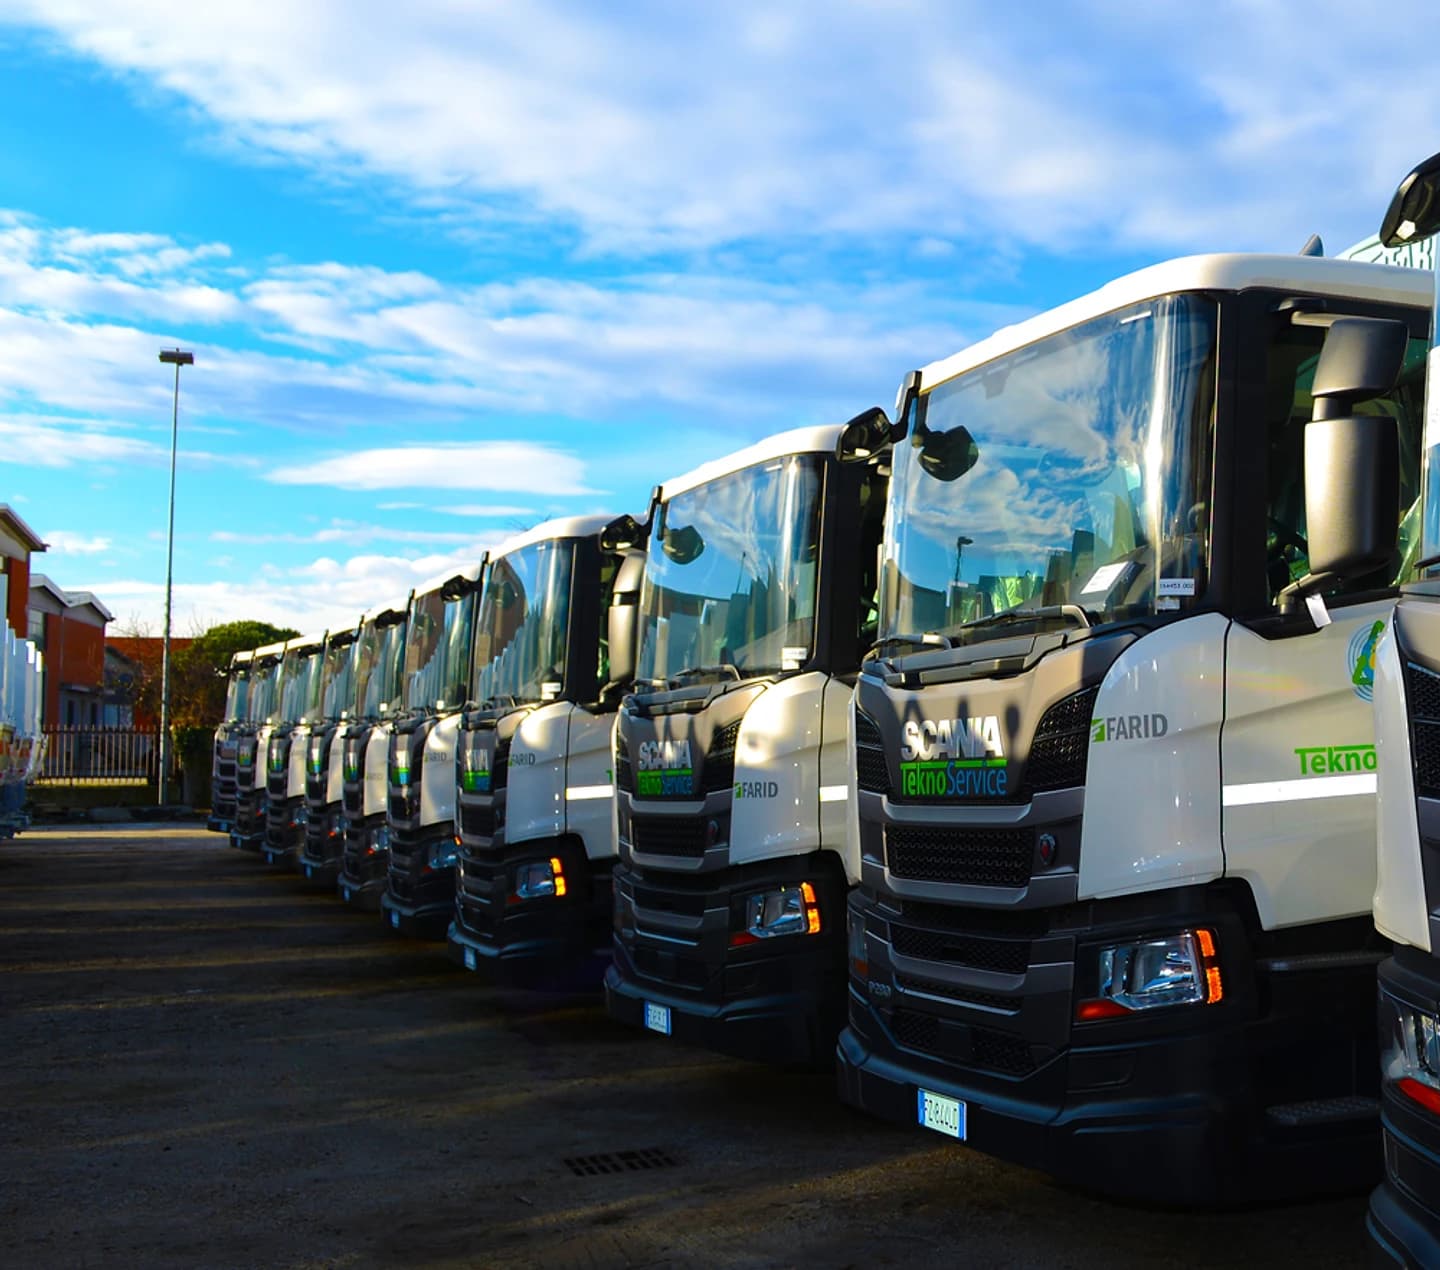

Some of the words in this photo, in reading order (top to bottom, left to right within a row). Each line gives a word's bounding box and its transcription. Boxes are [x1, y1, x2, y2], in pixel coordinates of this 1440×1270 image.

[900, 715, 1004, 761] SCANIA
[1106, 713, 1168, 741] FARID
[1294, 744, 1378, 775] Tekno
[743, 781, 778, 798] FARID
[900, 759, 1008, 796] TeknoService
